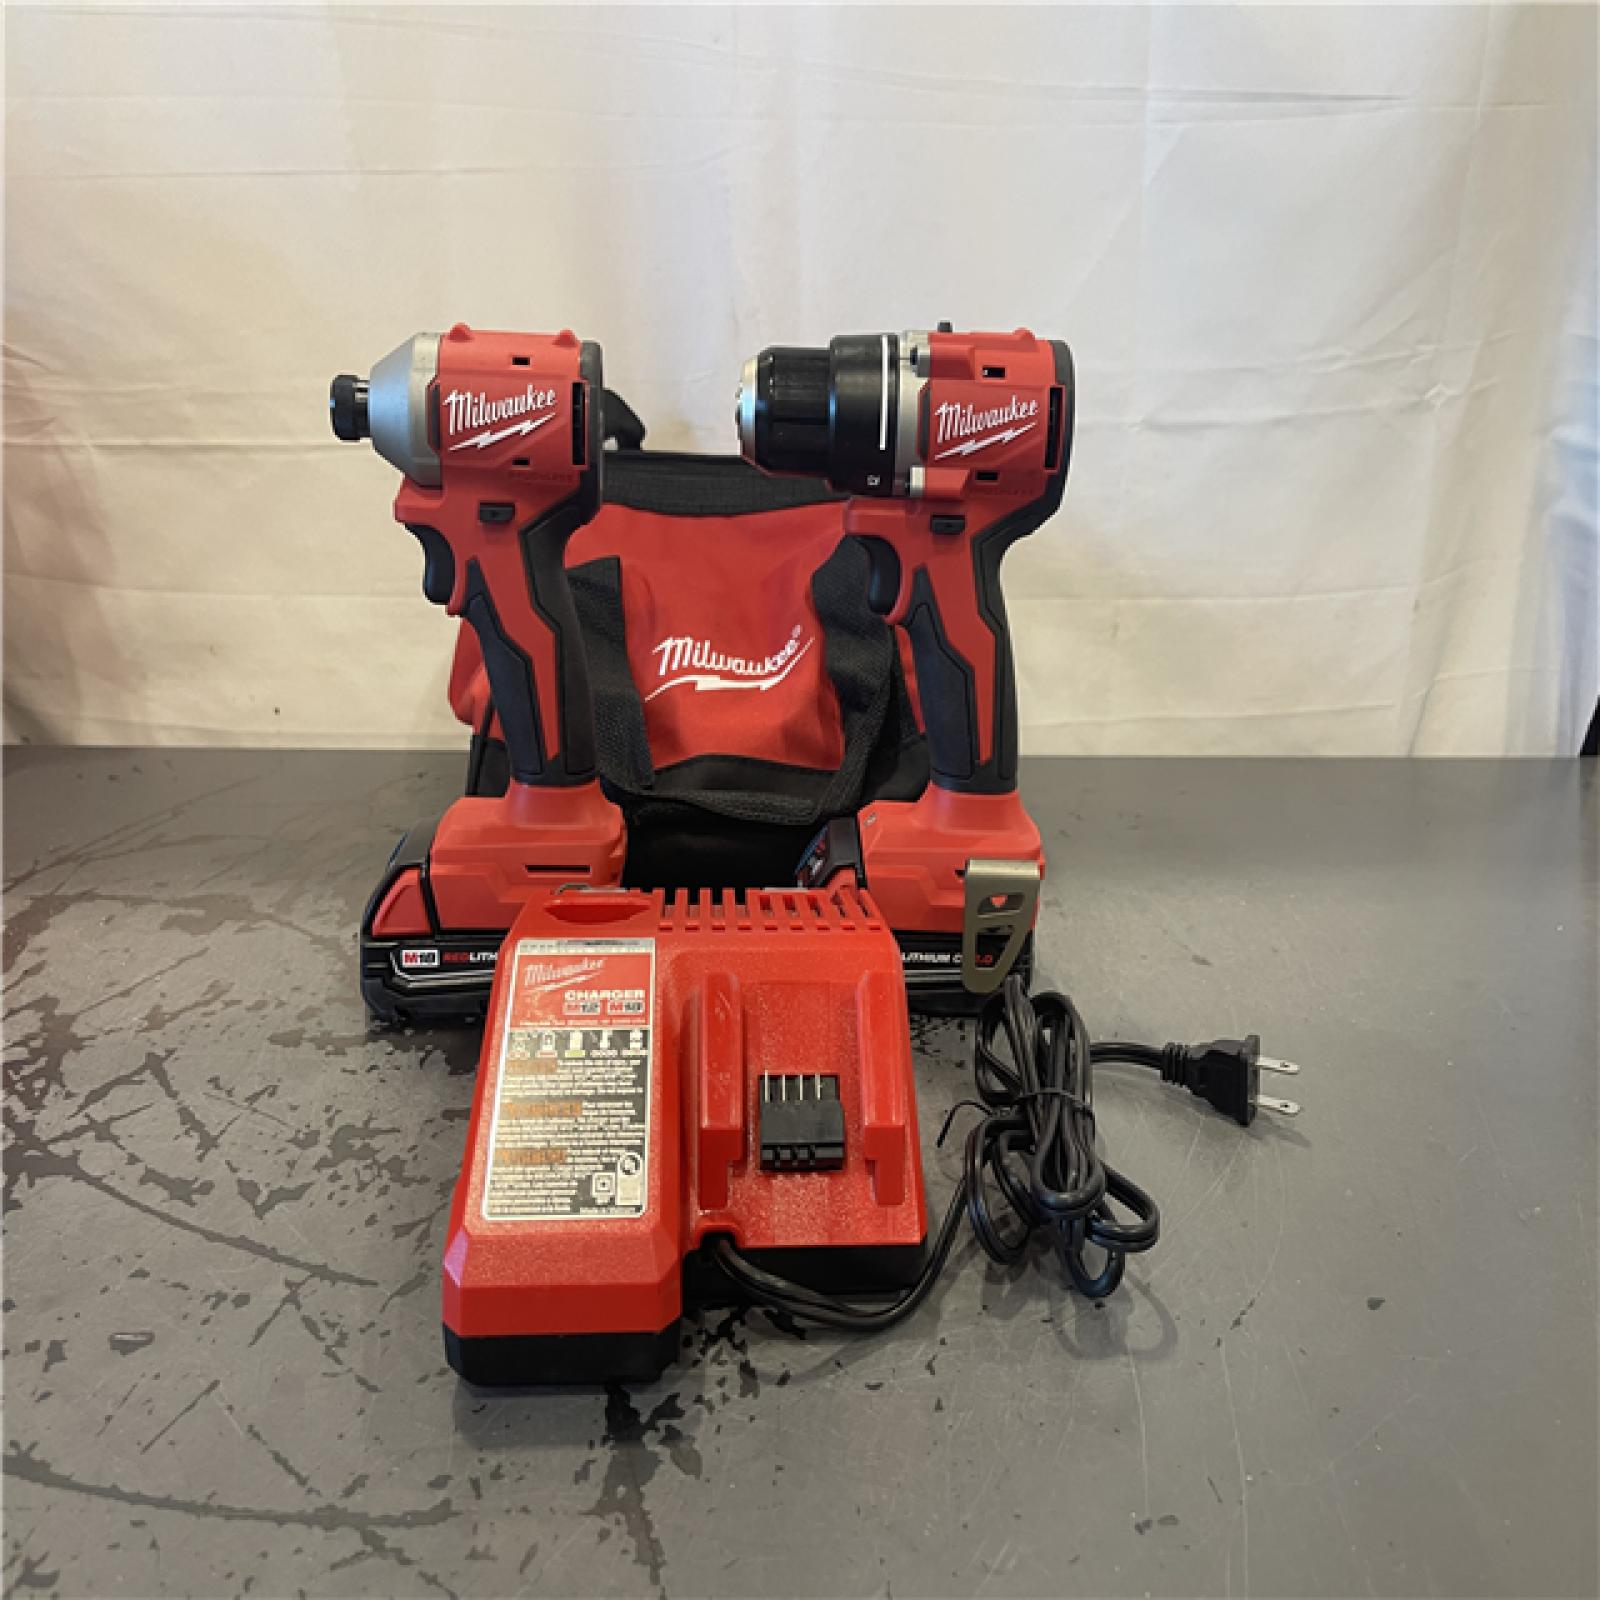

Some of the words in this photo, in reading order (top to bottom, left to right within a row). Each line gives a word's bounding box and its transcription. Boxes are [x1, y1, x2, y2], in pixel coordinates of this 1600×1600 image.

[443, 383, 557, 436] Milwaukee
[934, 395, 1038, 444] Milwaukee
[404, 951, 437, 966] M18
[523, 957, 606, 987] Milwaukee
[564, 989, 646, 1001] CHARGER
